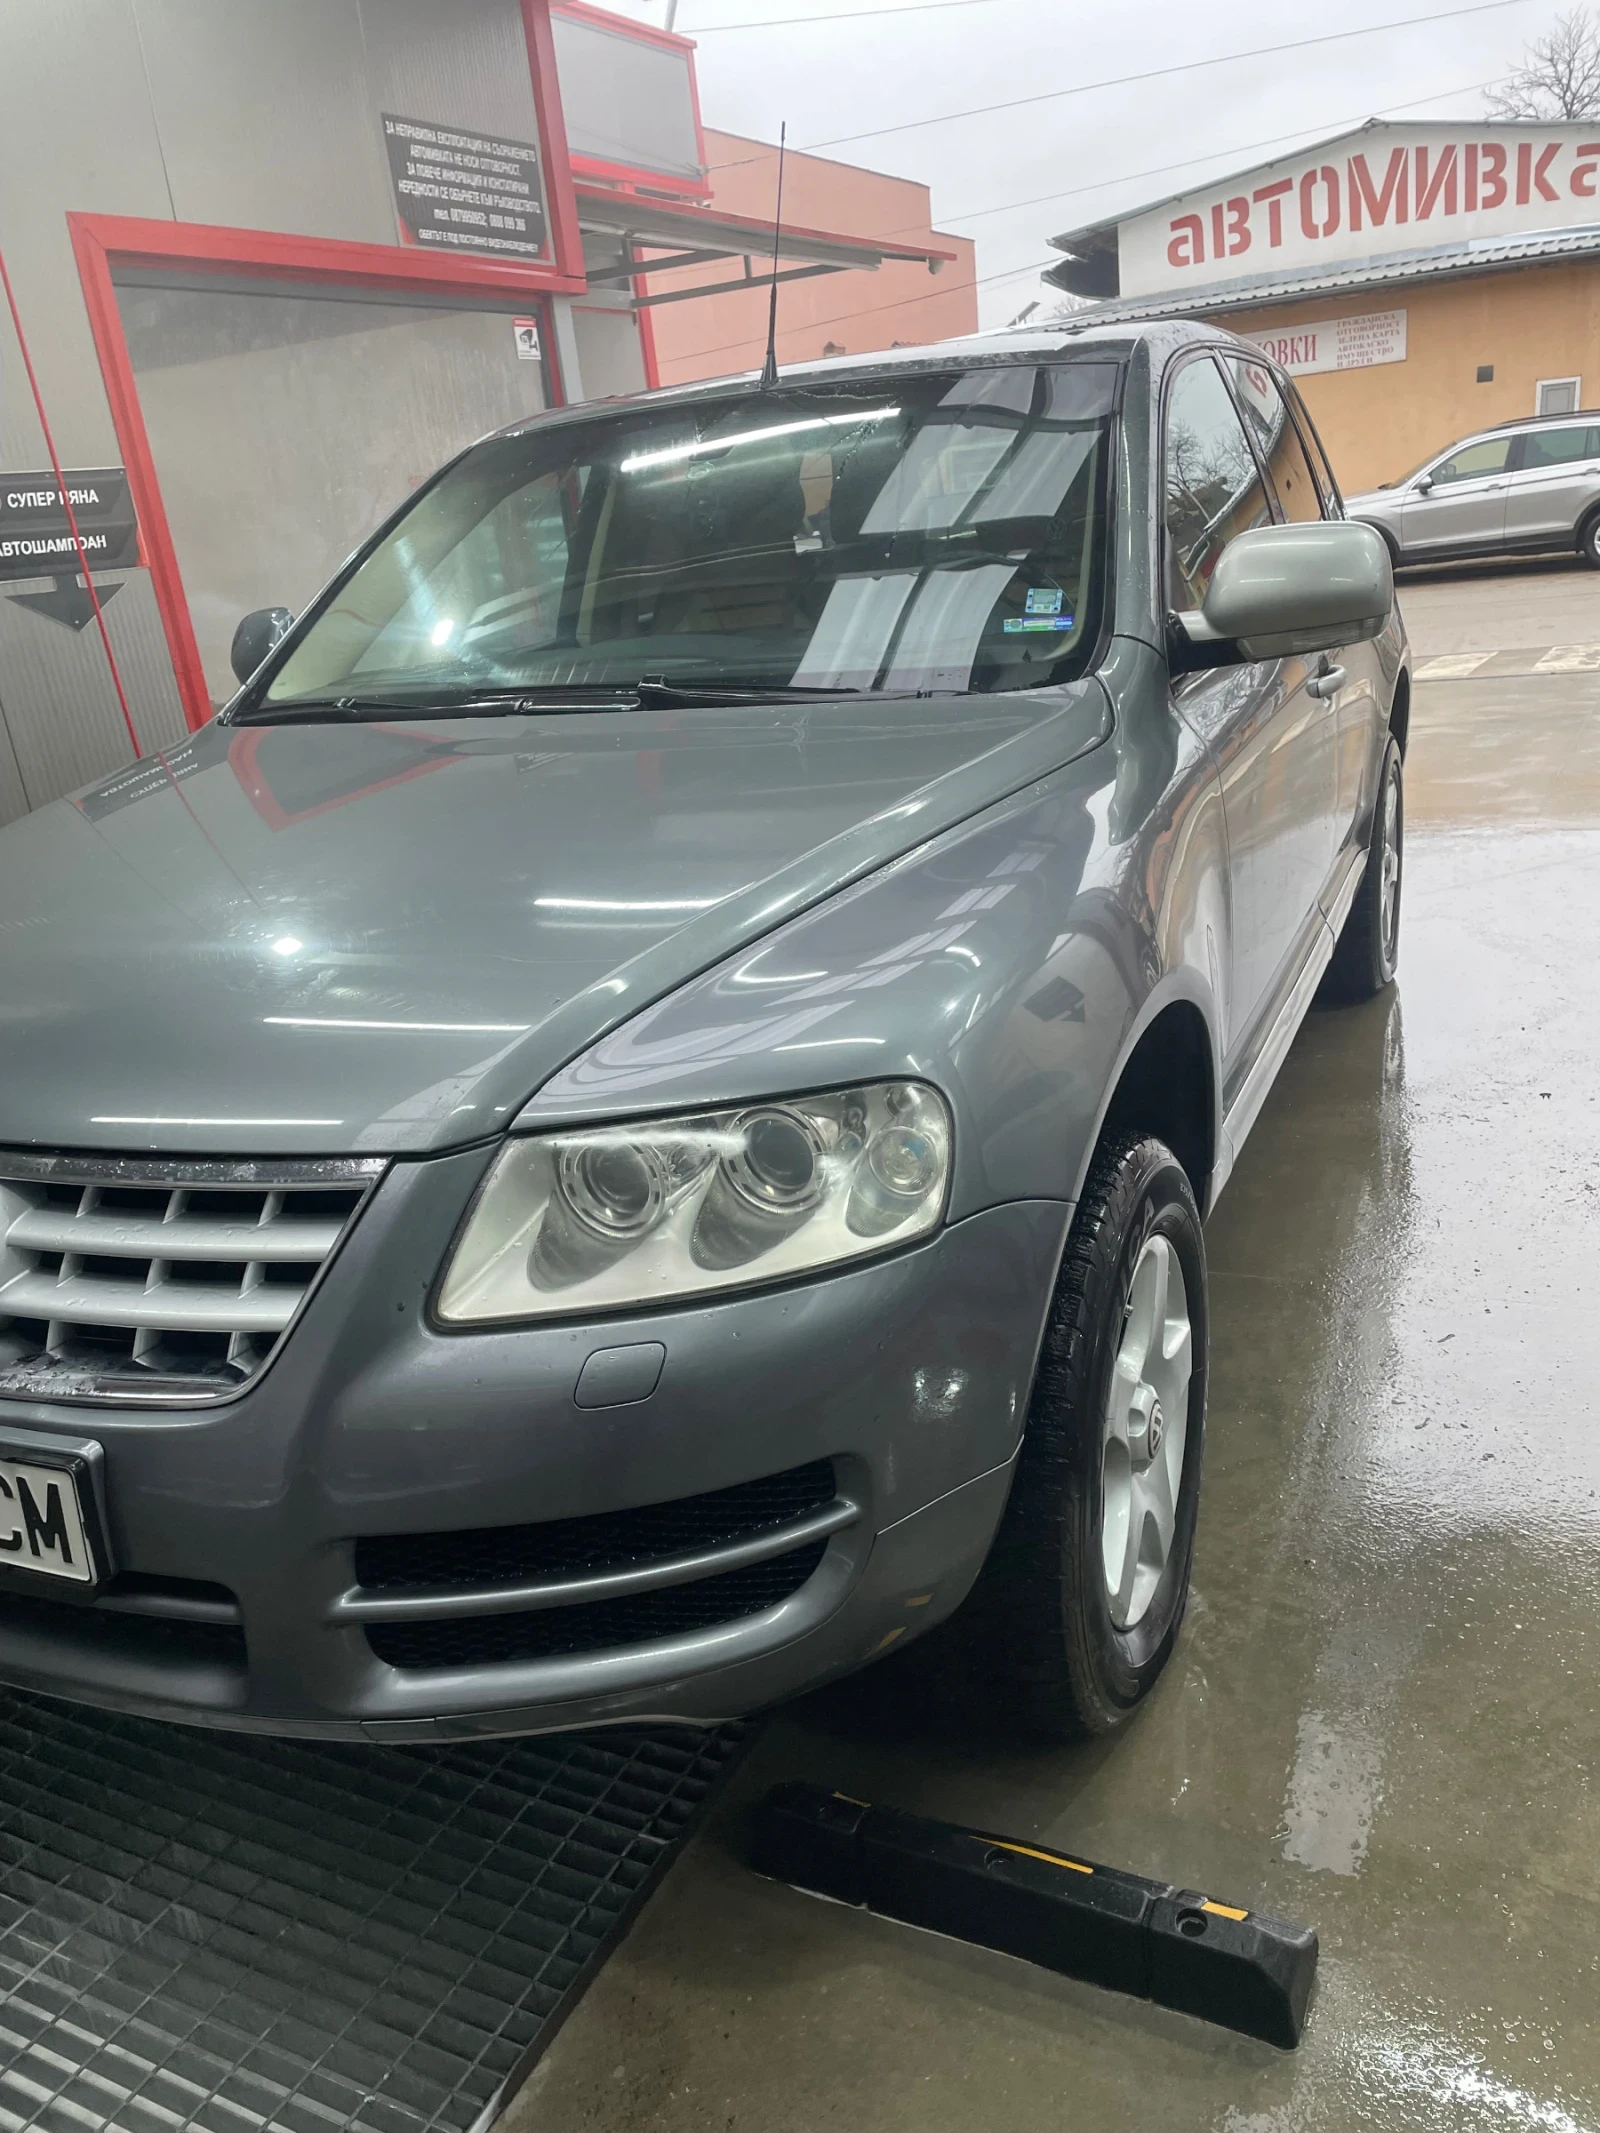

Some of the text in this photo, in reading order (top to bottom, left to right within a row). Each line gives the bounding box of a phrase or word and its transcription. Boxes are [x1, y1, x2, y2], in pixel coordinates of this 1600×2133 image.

[385, 121, 395, 134] ЗА
[1337, 313, 1396, 328] ГРАЖДАНСКА
[1337, 321, 1401, 336] ОТГОВОРНОСТ
[1337, 329, 1400, 345] ЗЕЛЕНА КАРТА
[1258, 334, 1317, 366] ОВКИ
[1337, 339, 1389, 353] АВТОКАСКО
[1337, 346, 1394, 361] ИМУЩЕСТВО
[7, 491, 56, 508] СУПЕР
